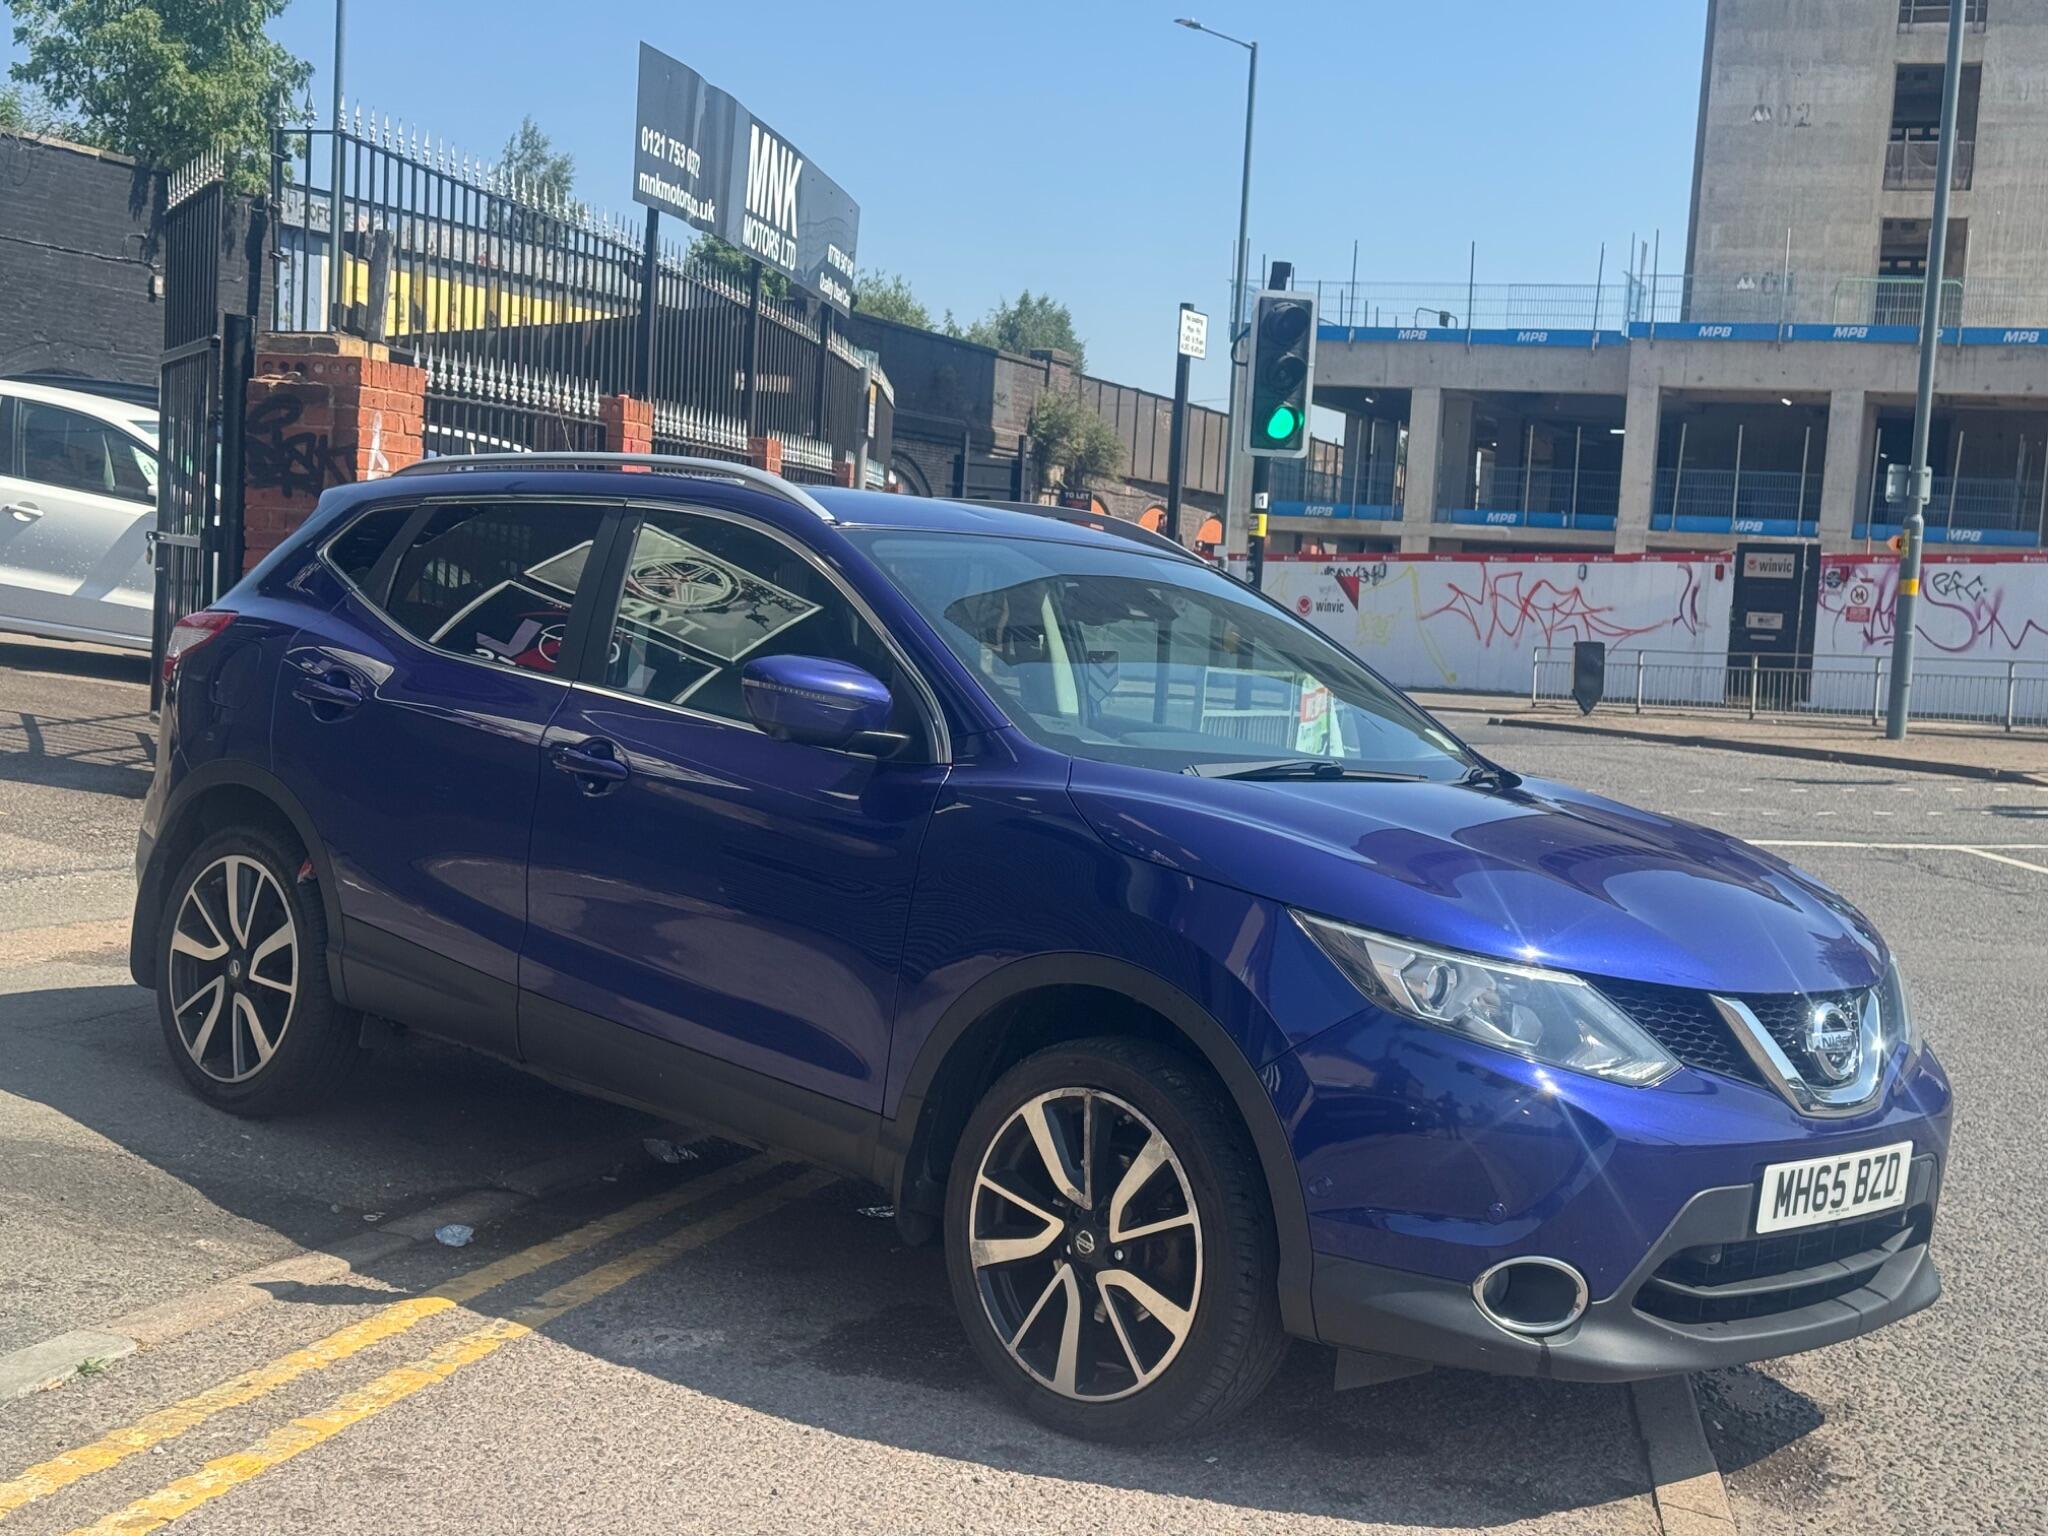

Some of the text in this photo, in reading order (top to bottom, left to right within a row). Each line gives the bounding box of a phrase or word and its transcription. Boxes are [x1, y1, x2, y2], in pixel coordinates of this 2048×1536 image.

[641, 126, 666, 159] 0121
[668, 138, 686, 169] 753
[746, 123, 803, 239] MNK
[742, 213, 780, 262] MOTORS
[780, 236, 797, 271] LTD
[1398, 330, 1428, 340] MPB
[1517, 331, 1548, 342] MPB
[1698, 326, 1733, 337] MPB
[1833, 326, 1868, 338] MPB
[2003, 330, 2040, 343] MPB
[1259, 495, 1265, 507] 1
[1304, 505, 1333, 516] MPB
[1486, 512, 1518, 524] MPB
[1733, 520, 1764, 532] MPB
[1947, 529, 1982, 542] MPB
[1760, 557, 1793, 573] winvic
[1315, 598, 1345, 613] winvic
[1773, 1152, 1901, 1219] MH65 BZD
